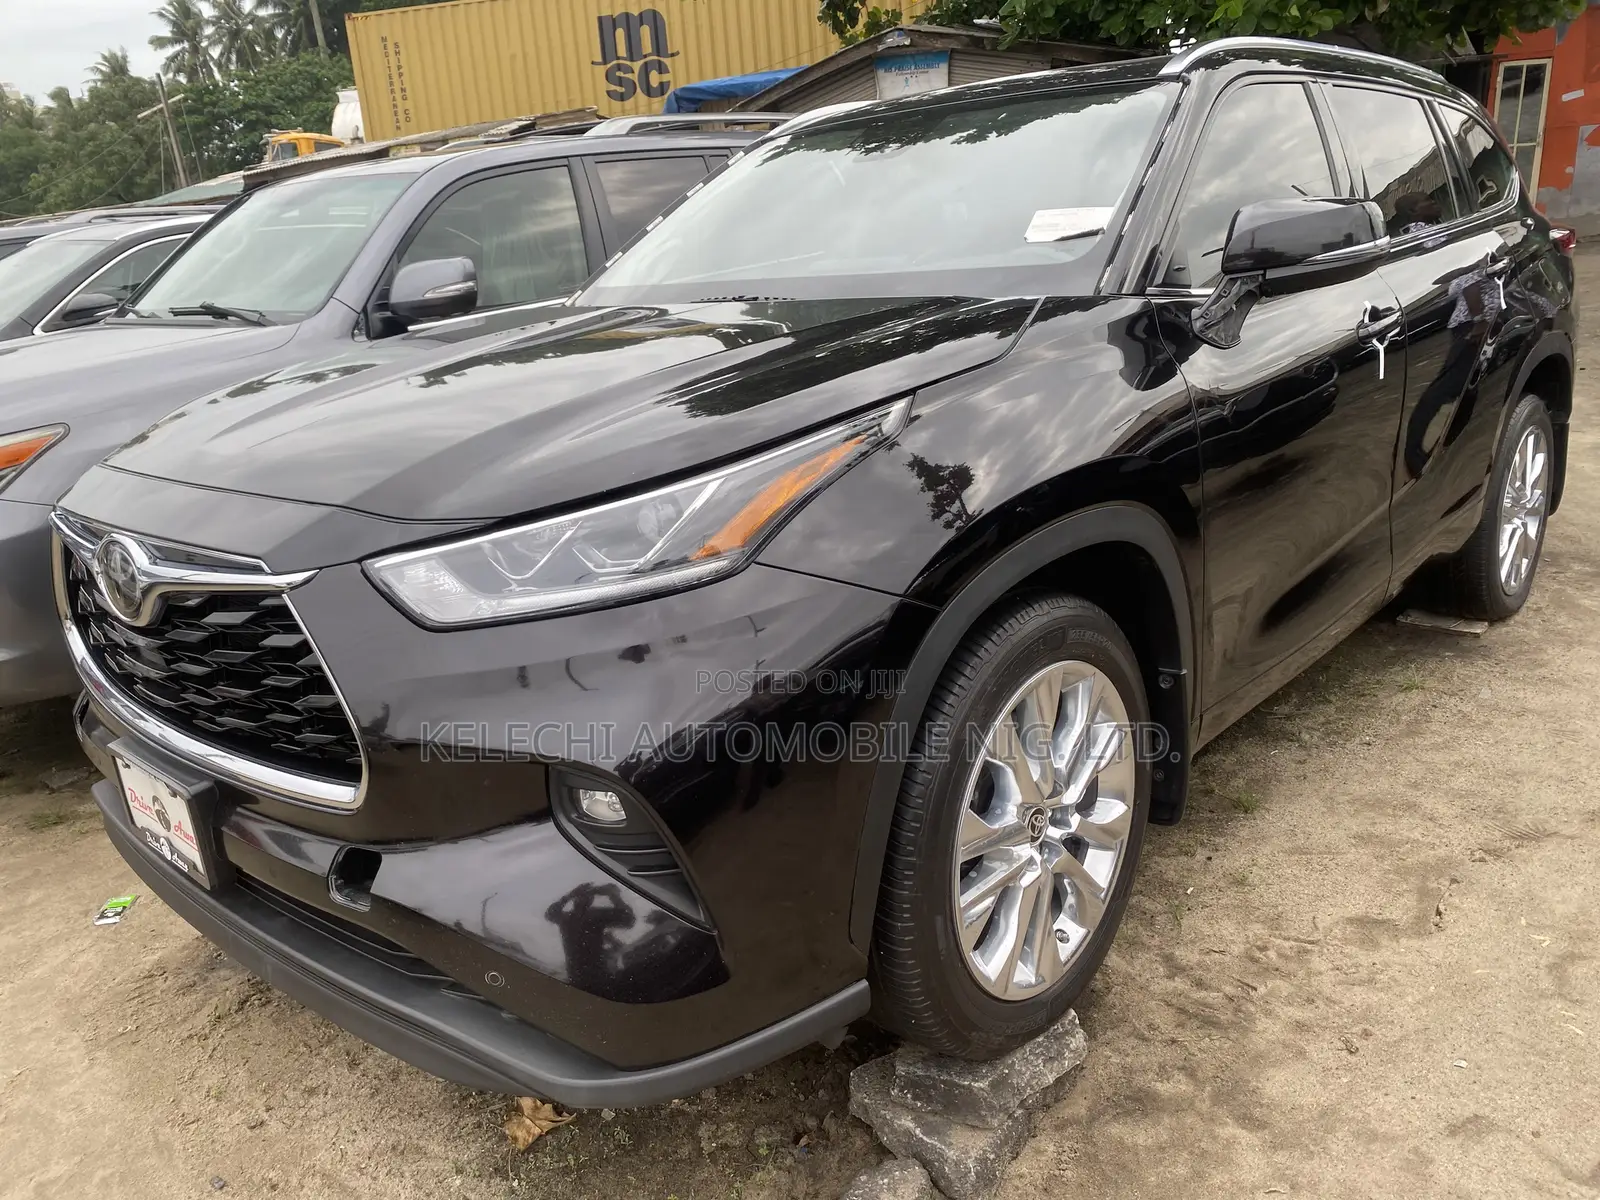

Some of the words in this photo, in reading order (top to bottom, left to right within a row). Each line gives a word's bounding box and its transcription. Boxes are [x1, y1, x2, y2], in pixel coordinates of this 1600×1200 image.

[381, 36, 401, 131] MEDITERRANEAN
[394, 42, 408, 101] SHIPPING
[404, 108, 411, 123] CO
[128, 787, 155, 815] Drive
[173, 820, 196, 846] Awa
